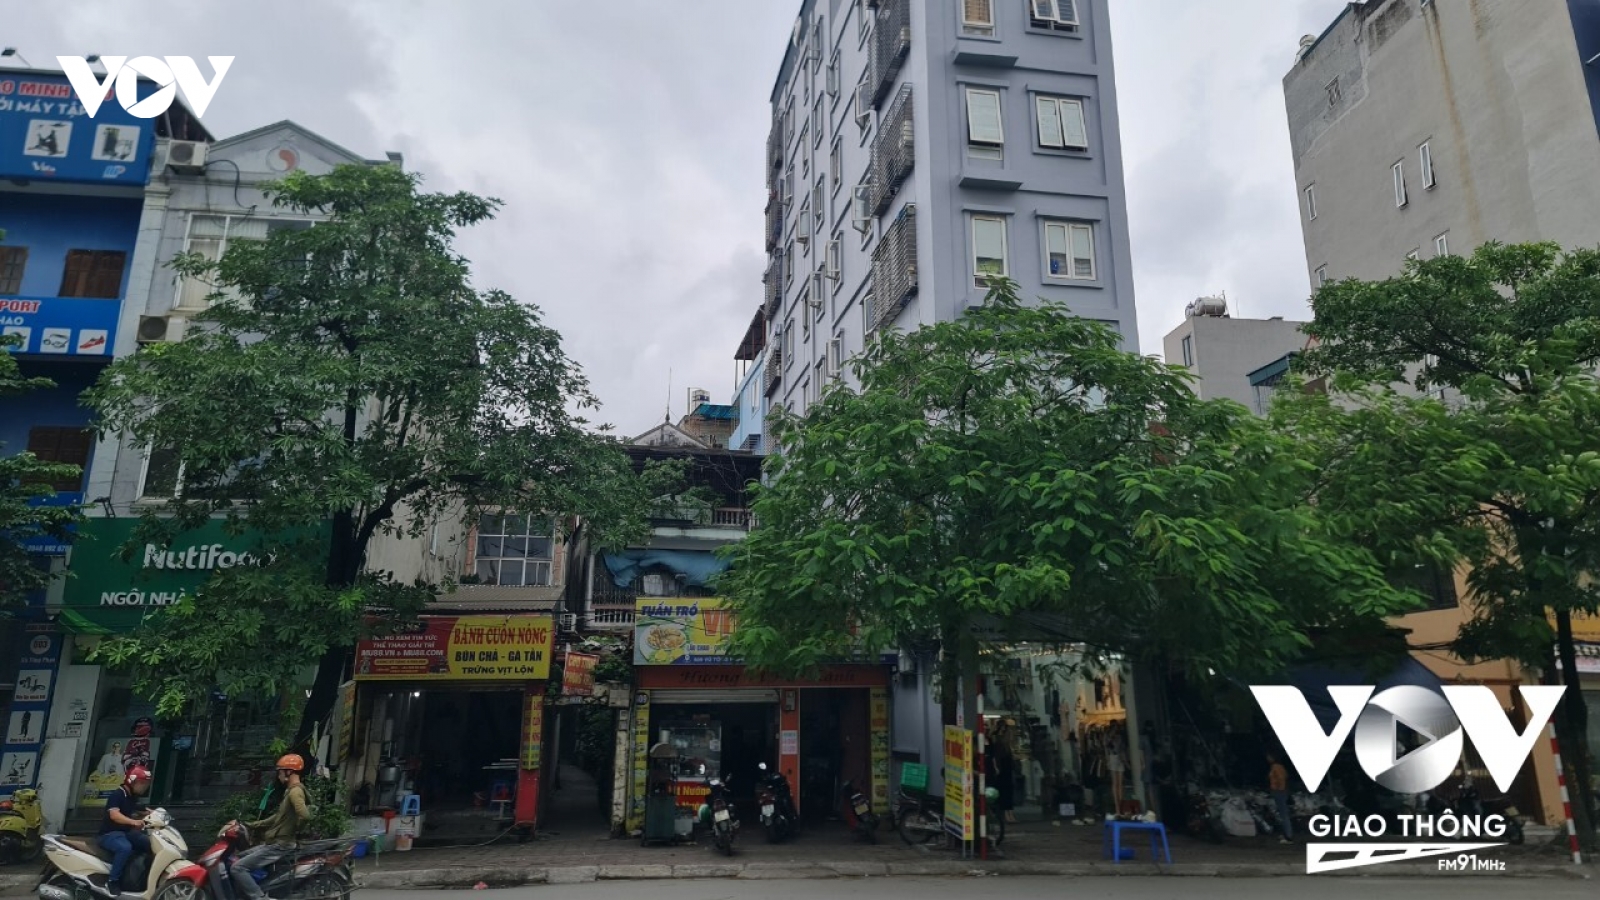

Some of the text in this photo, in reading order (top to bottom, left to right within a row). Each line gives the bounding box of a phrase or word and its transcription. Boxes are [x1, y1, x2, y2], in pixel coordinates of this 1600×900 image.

[18, 82, 71, 98] MINH
[100, 587, 145, 605] NGÔI
[641, 601, 673, 616] TUẤN
[453, 623, 484, 645] BÁNH
[517, 622, 547, 645] NÓNG
[462, 664, 535, 676] TRỨNG VỊT LỘN
